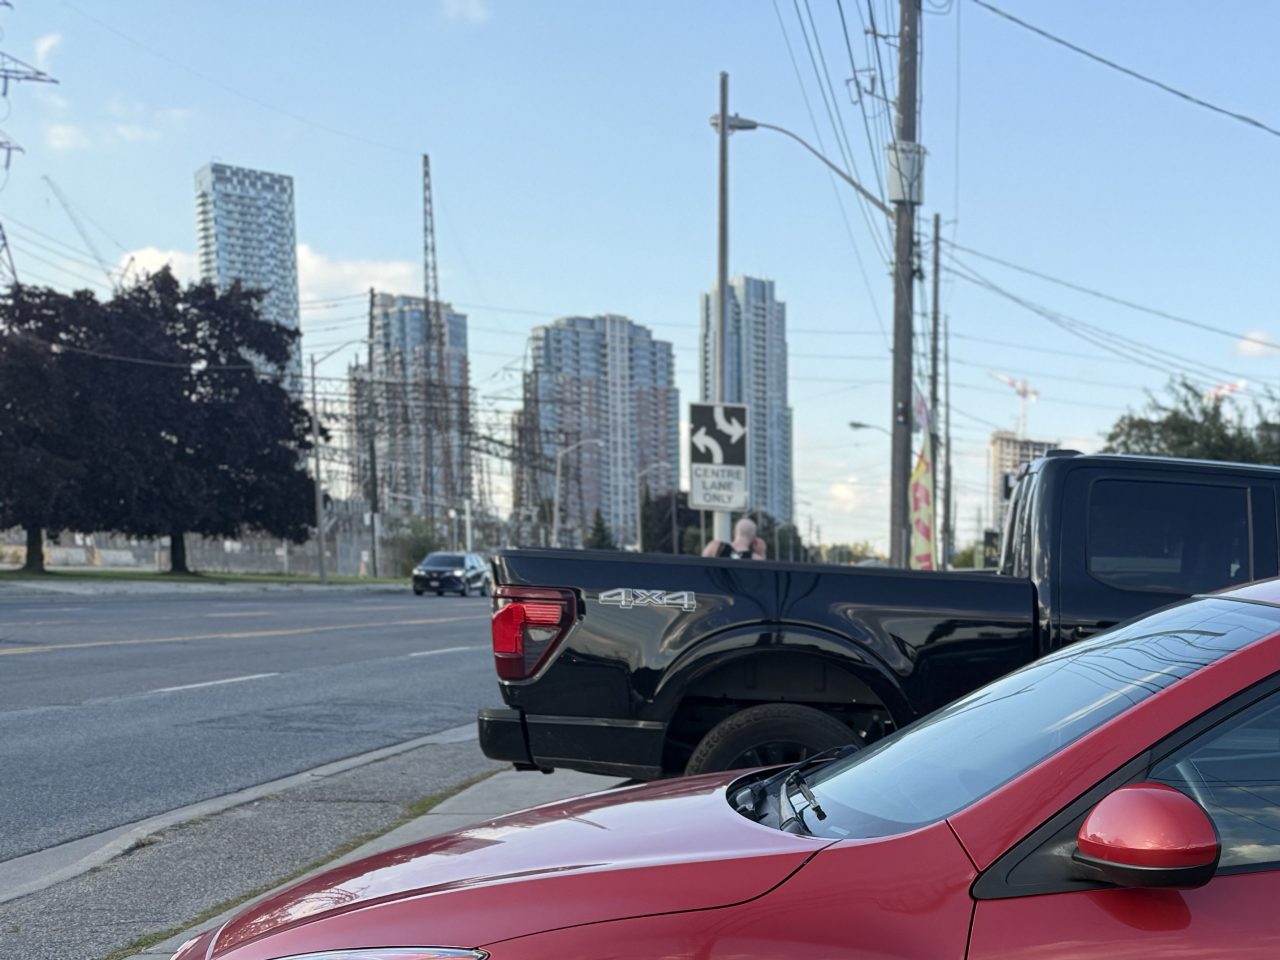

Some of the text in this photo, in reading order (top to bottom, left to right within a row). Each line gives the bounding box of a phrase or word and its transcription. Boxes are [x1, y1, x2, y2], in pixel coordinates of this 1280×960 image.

[694, 467, 743, 479] CENTRE
[702, 481, 735, 492] LANE
[703, 493, 734, 504] ONLY
